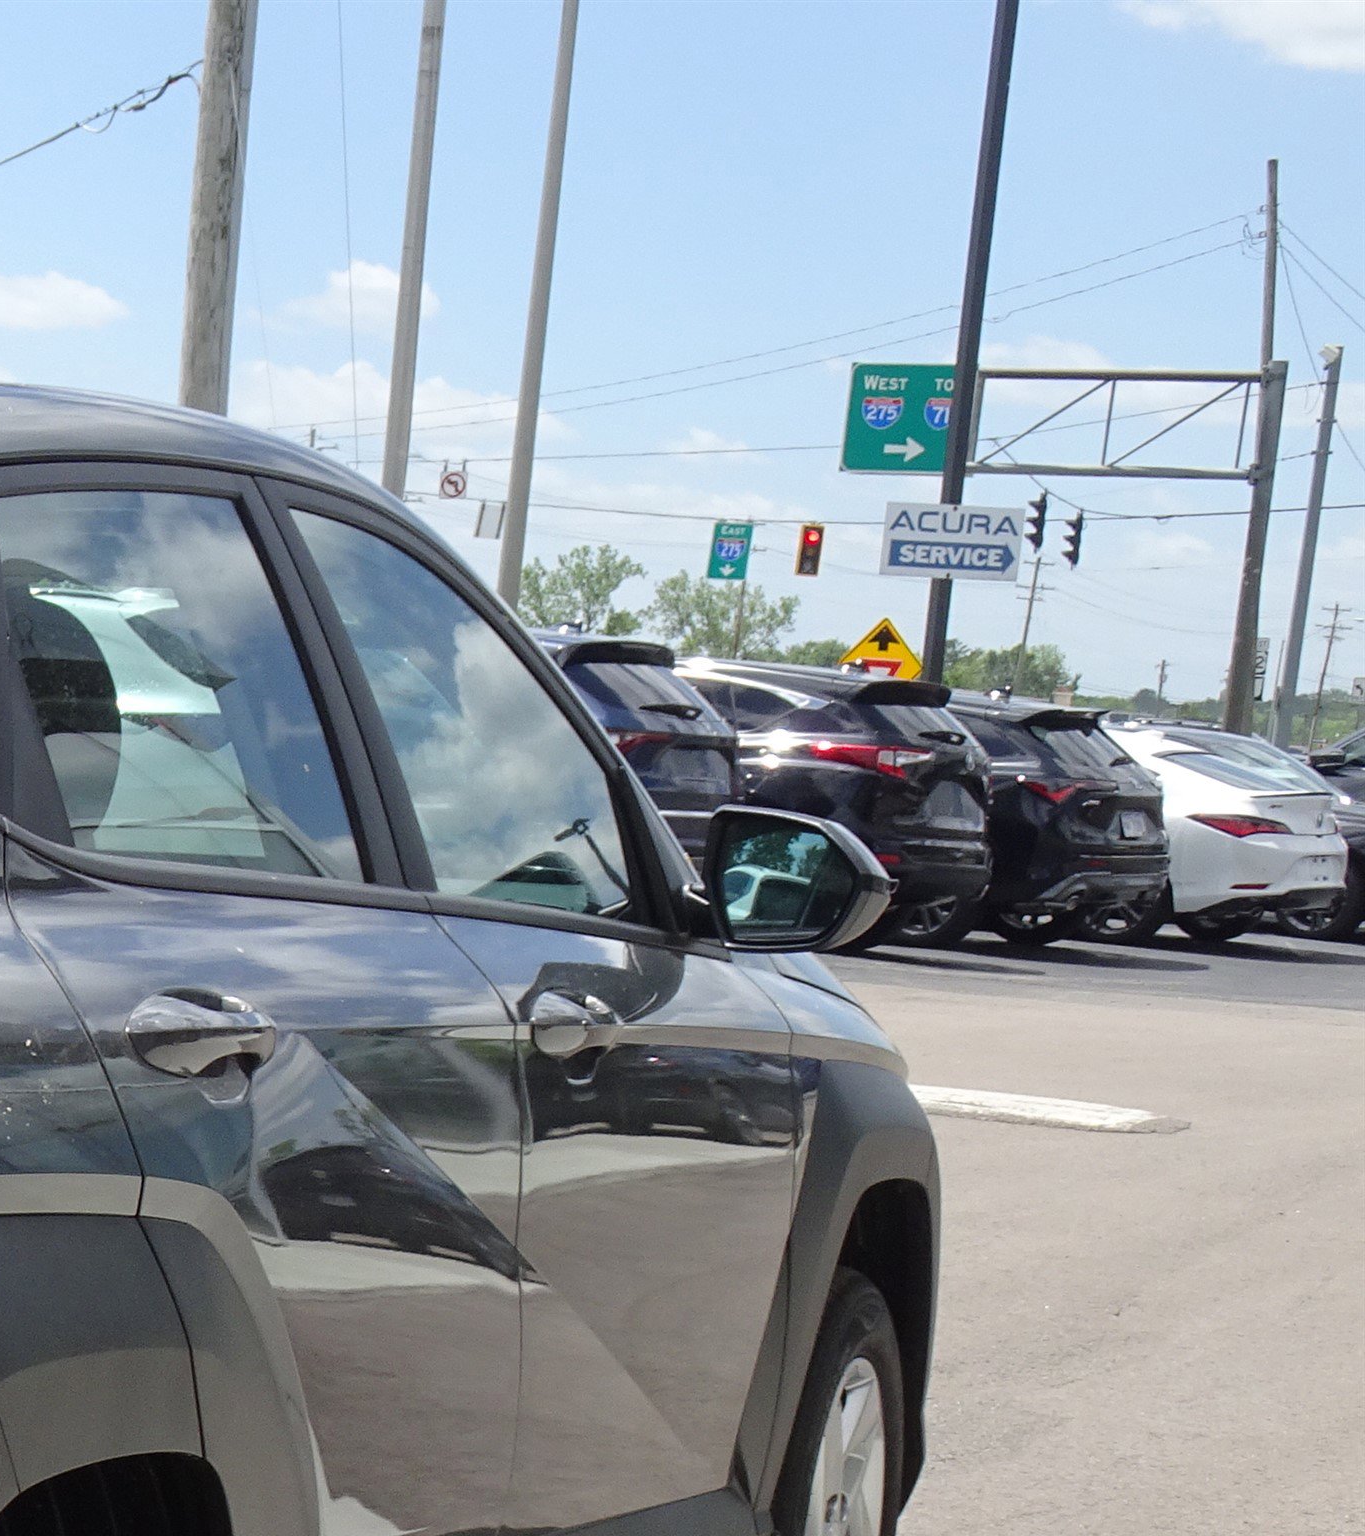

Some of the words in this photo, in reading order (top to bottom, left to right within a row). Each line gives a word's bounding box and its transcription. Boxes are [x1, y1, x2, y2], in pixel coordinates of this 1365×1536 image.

[864, 374, 909, 391] WEST
[934, 378, 954, 392] TO
[866, 405, 898, 422] 275
[932, 406, 950, 424] 71
[720, 525, 746, 535] EAST
[889, 510, 1018, 536] ACURA
[721, 542, 742, 557] 275
[899, 544, 1004, 568] SERVICE
